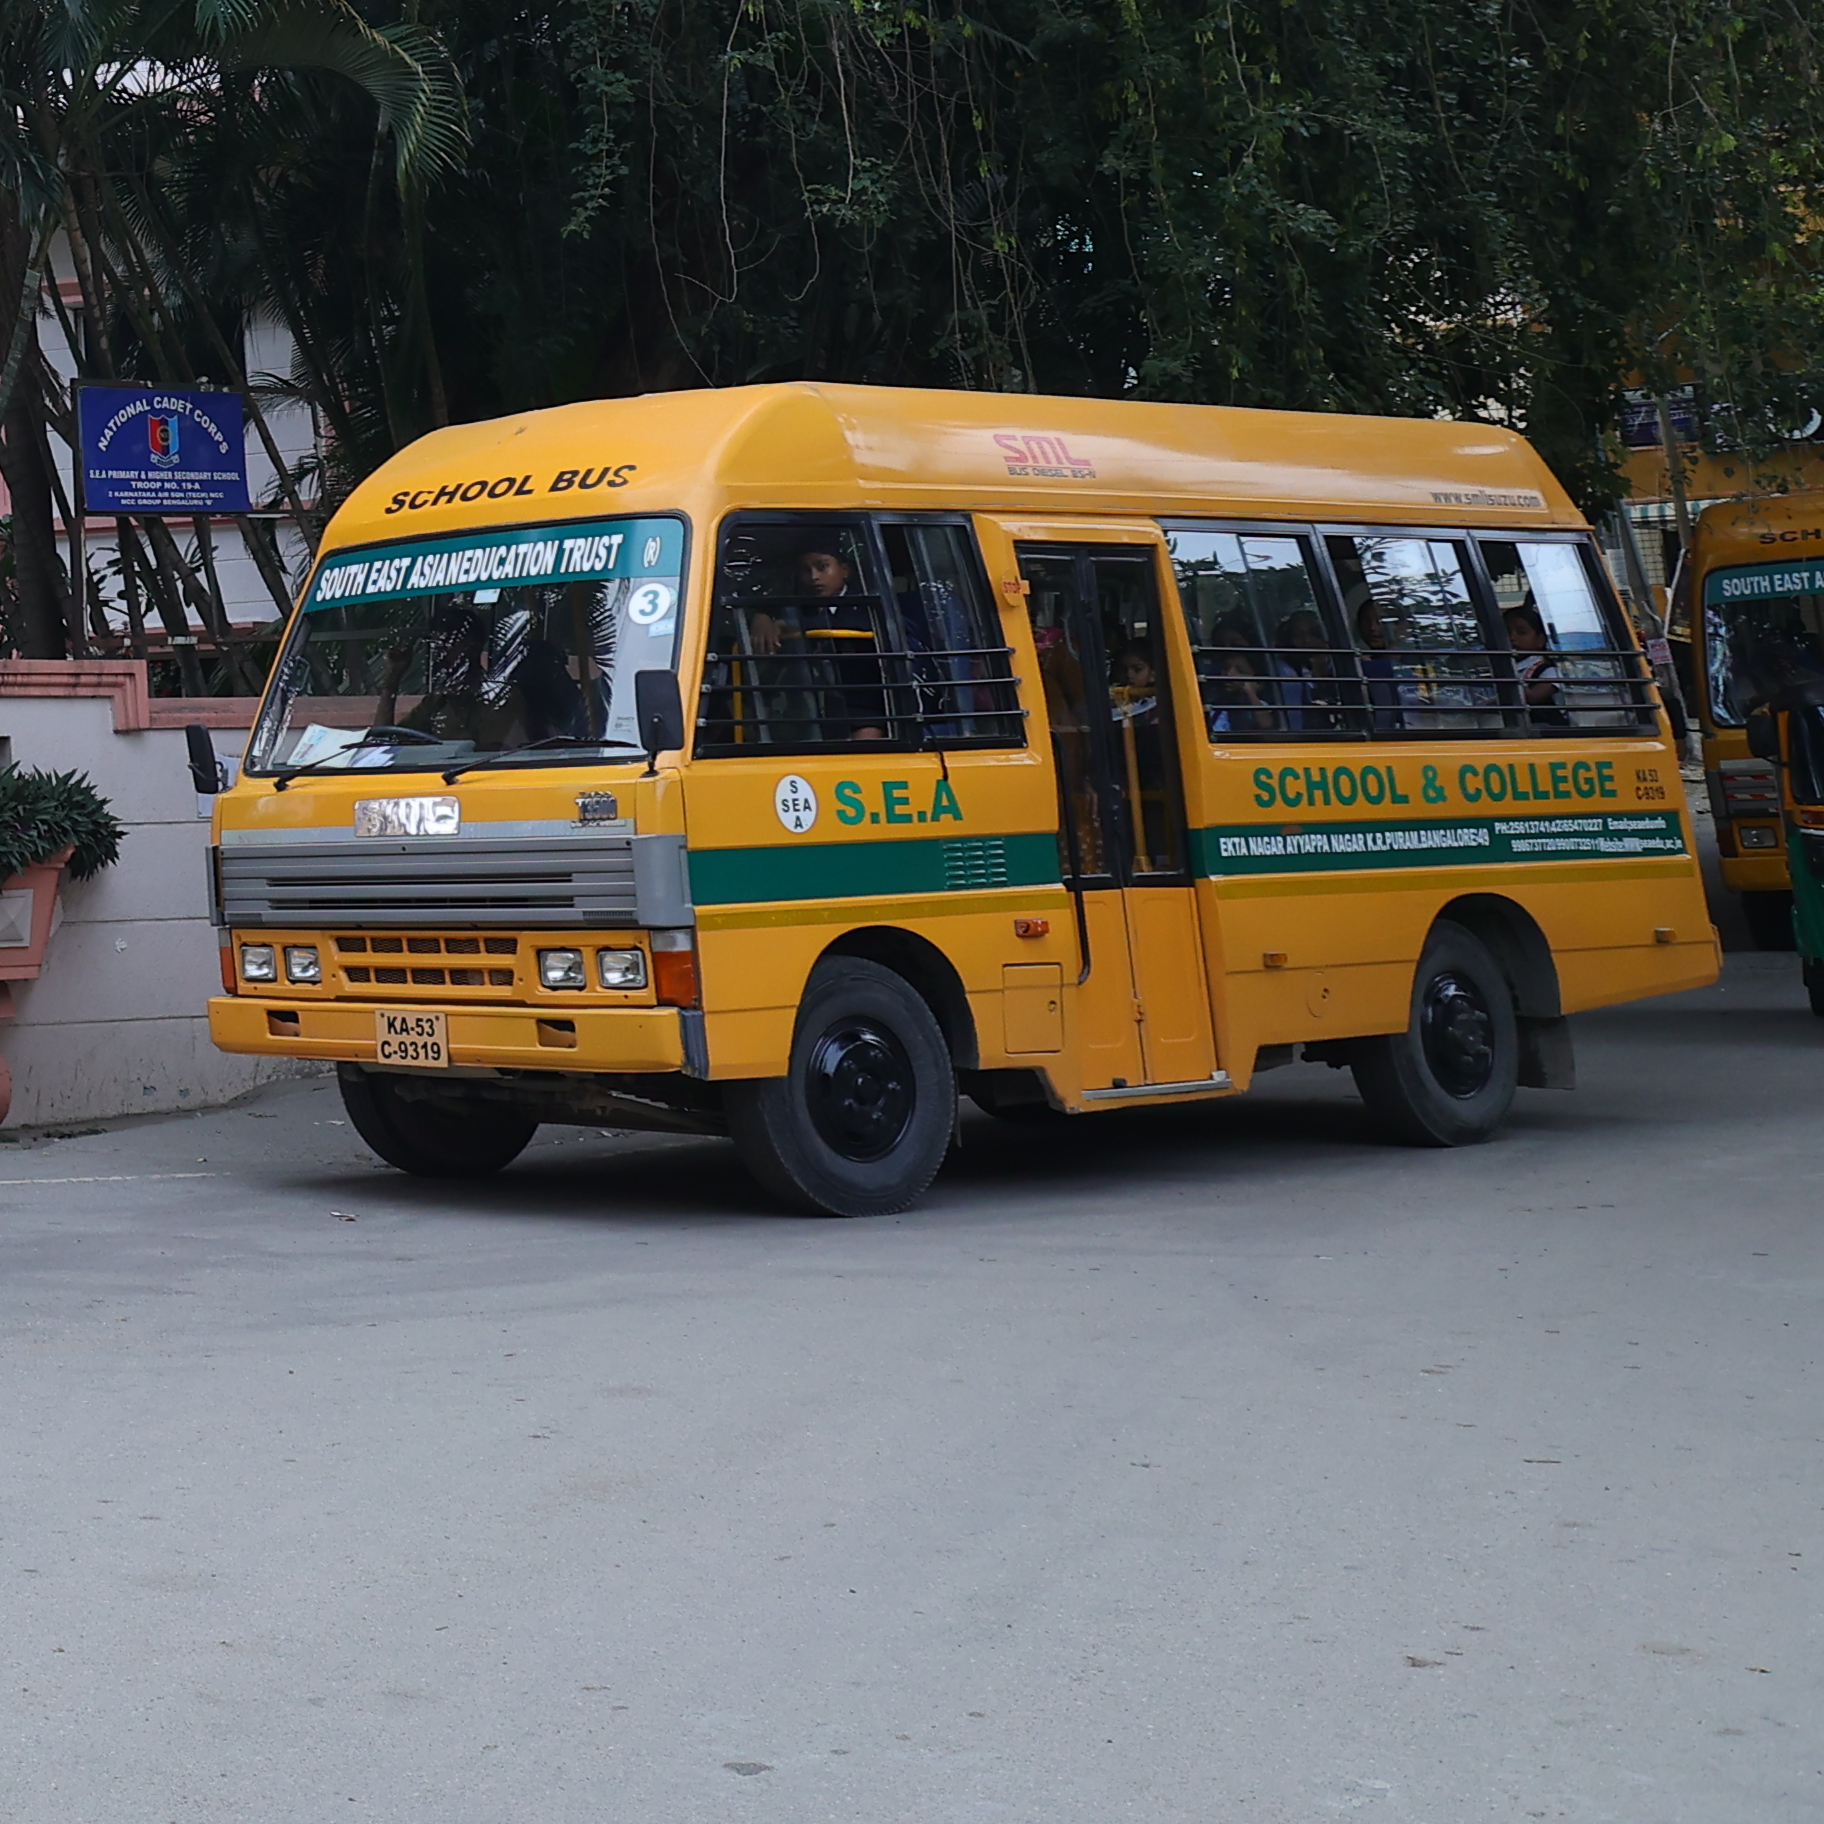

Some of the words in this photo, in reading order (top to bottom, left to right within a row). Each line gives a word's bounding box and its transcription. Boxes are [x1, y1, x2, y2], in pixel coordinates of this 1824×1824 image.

[97, 398, 151, 452] NATIONAL
[153, 395, 193, 416] CADET
[193, 409, 230, 454] CORPS
[993, 434, 1092, 466] SML
[108, 470, 139, 480] PRIMARY
[147, 470, 173, 480] HIGHER
[174, 471, 212, 481] SECONDARY
[213, 472, 240, 481] SCHOOL
[130, 481, 162, 489] TROOP
[384, 474, 536, 515] SCHOOL
[548, 464, 638, 493] BUS
[316, 566, 365, 602] SOUTH
[366, 556, 412, 595] EAST
[560, 533, 624, 574] TRUST
[642, 536, 662, 568] (R)
[1722, 576, 1771, 596] SOUTH
[1774, 572, 1810, 592] EAST
[639, 589, 661, 617] 3
[1253, 765, 1410, 809] SCHOOL
[1420, 764, 1448, 804] &
[1458, 760, 1618, 804] COLLEGE
[834, 778, 964, 826] S.E.A
[1219, 837, 1249, 857] EKTA
[1250, 836, 1285, 857] NAGAR
[1286, 834, 1330, 855] AYYAPPA
[1330, 833, 1366, 853] NAGAR
[387, 1016, 436, 1038] KA-53
[381, 1040, 441, 1061] C-9319
